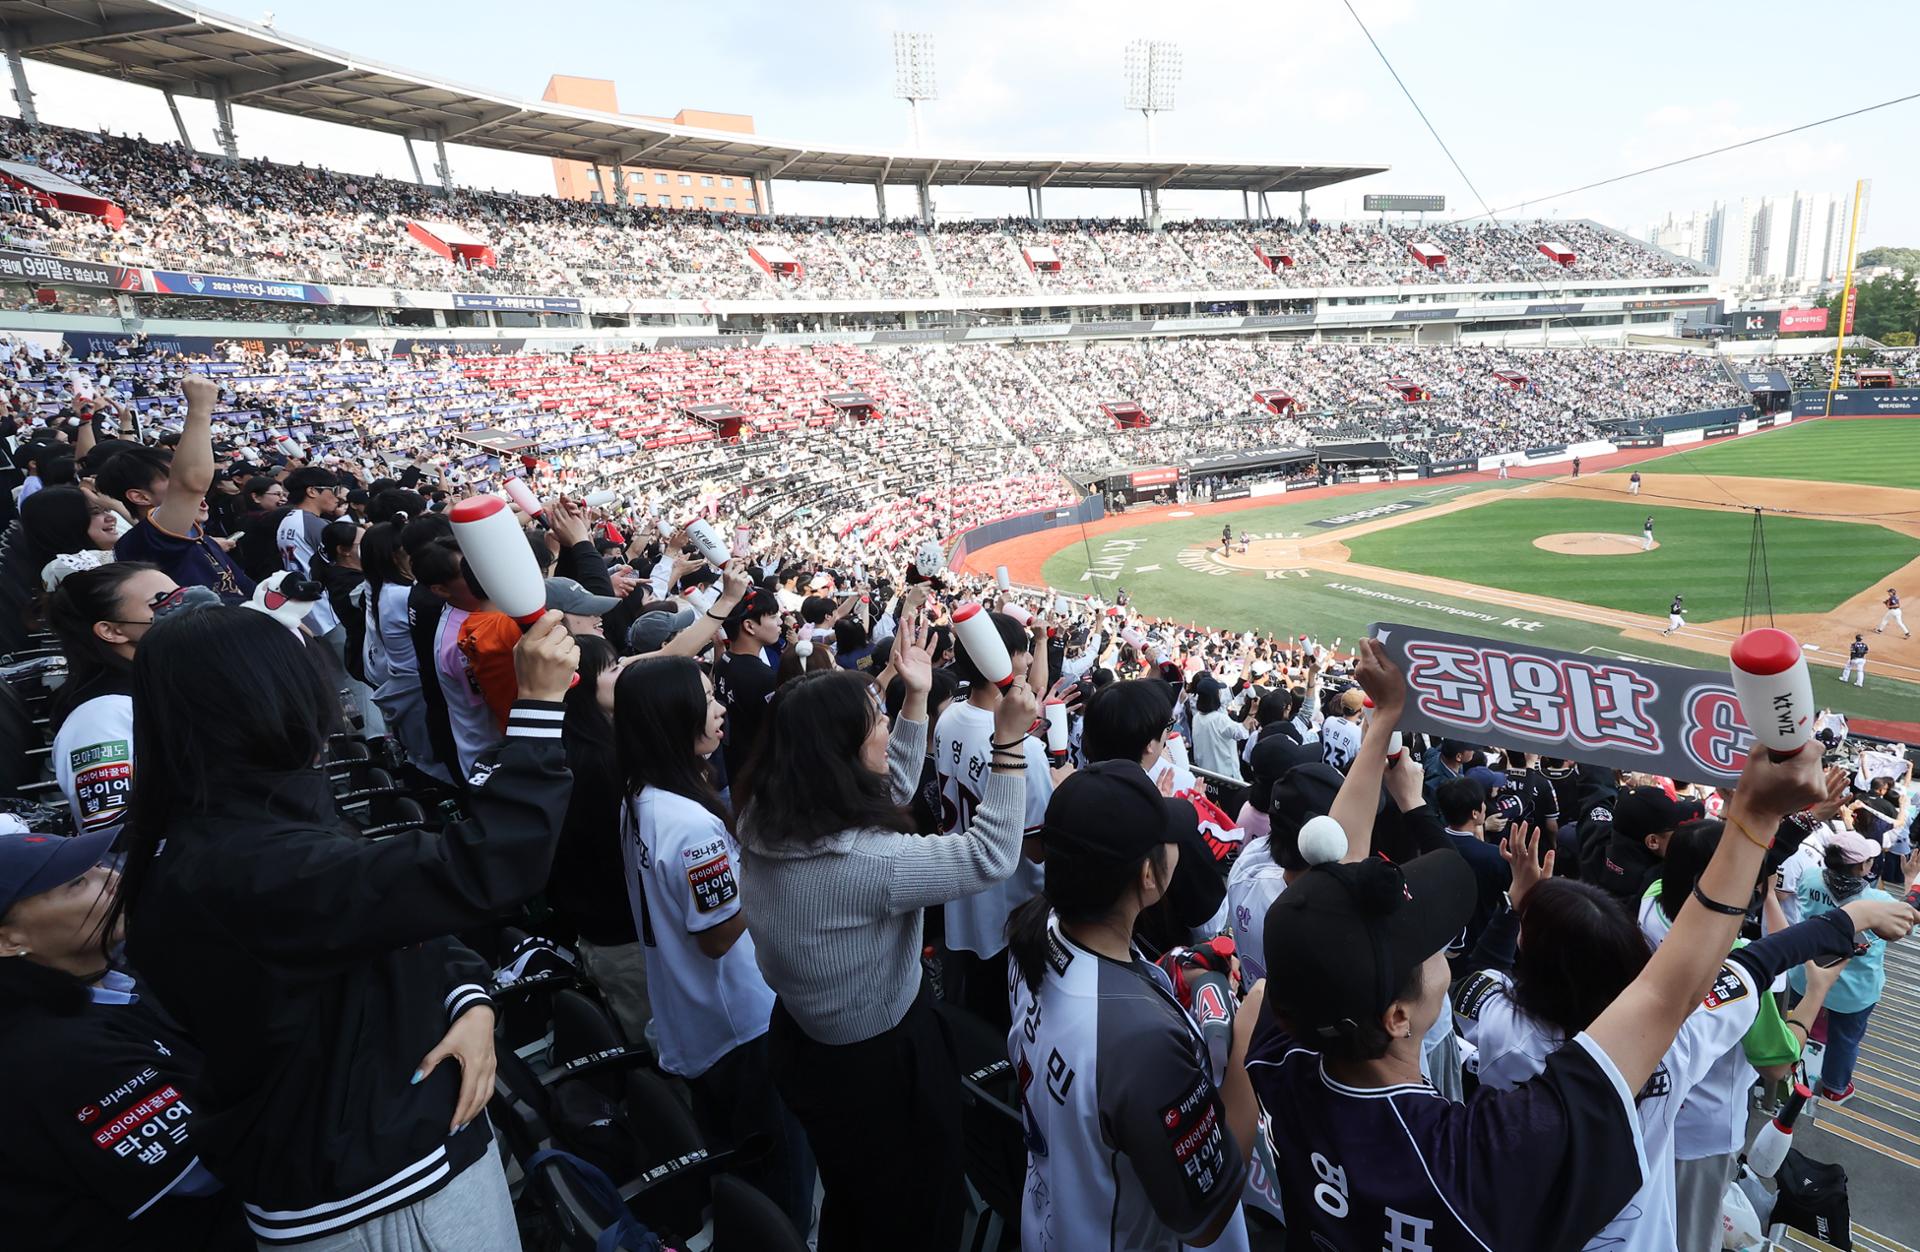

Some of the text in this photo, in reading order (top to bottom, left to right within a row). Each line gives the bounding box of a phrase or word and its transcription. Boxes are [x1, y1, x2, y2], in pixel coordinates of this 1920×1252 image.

[74, 267, 110, 285] 없습니다
[1745, 315, 1765, 330] kt
[1264, 569, 1312, 581] KT
[1323, 582, 1544, 633] AX Platform Company kt
[71, 744, 126, 767] 모아미래도
[78, 777, 130, 799] 타이어
[695, 870, 733, 896] 타이어
[99, 1067, 159, 1107] 비씨카드
[97, 1086, 179, 1145] 타이어바꿀때
[113, 1100, 193, 1158] 타이어
[1183, 1121, 1222, 1177] 타이어
